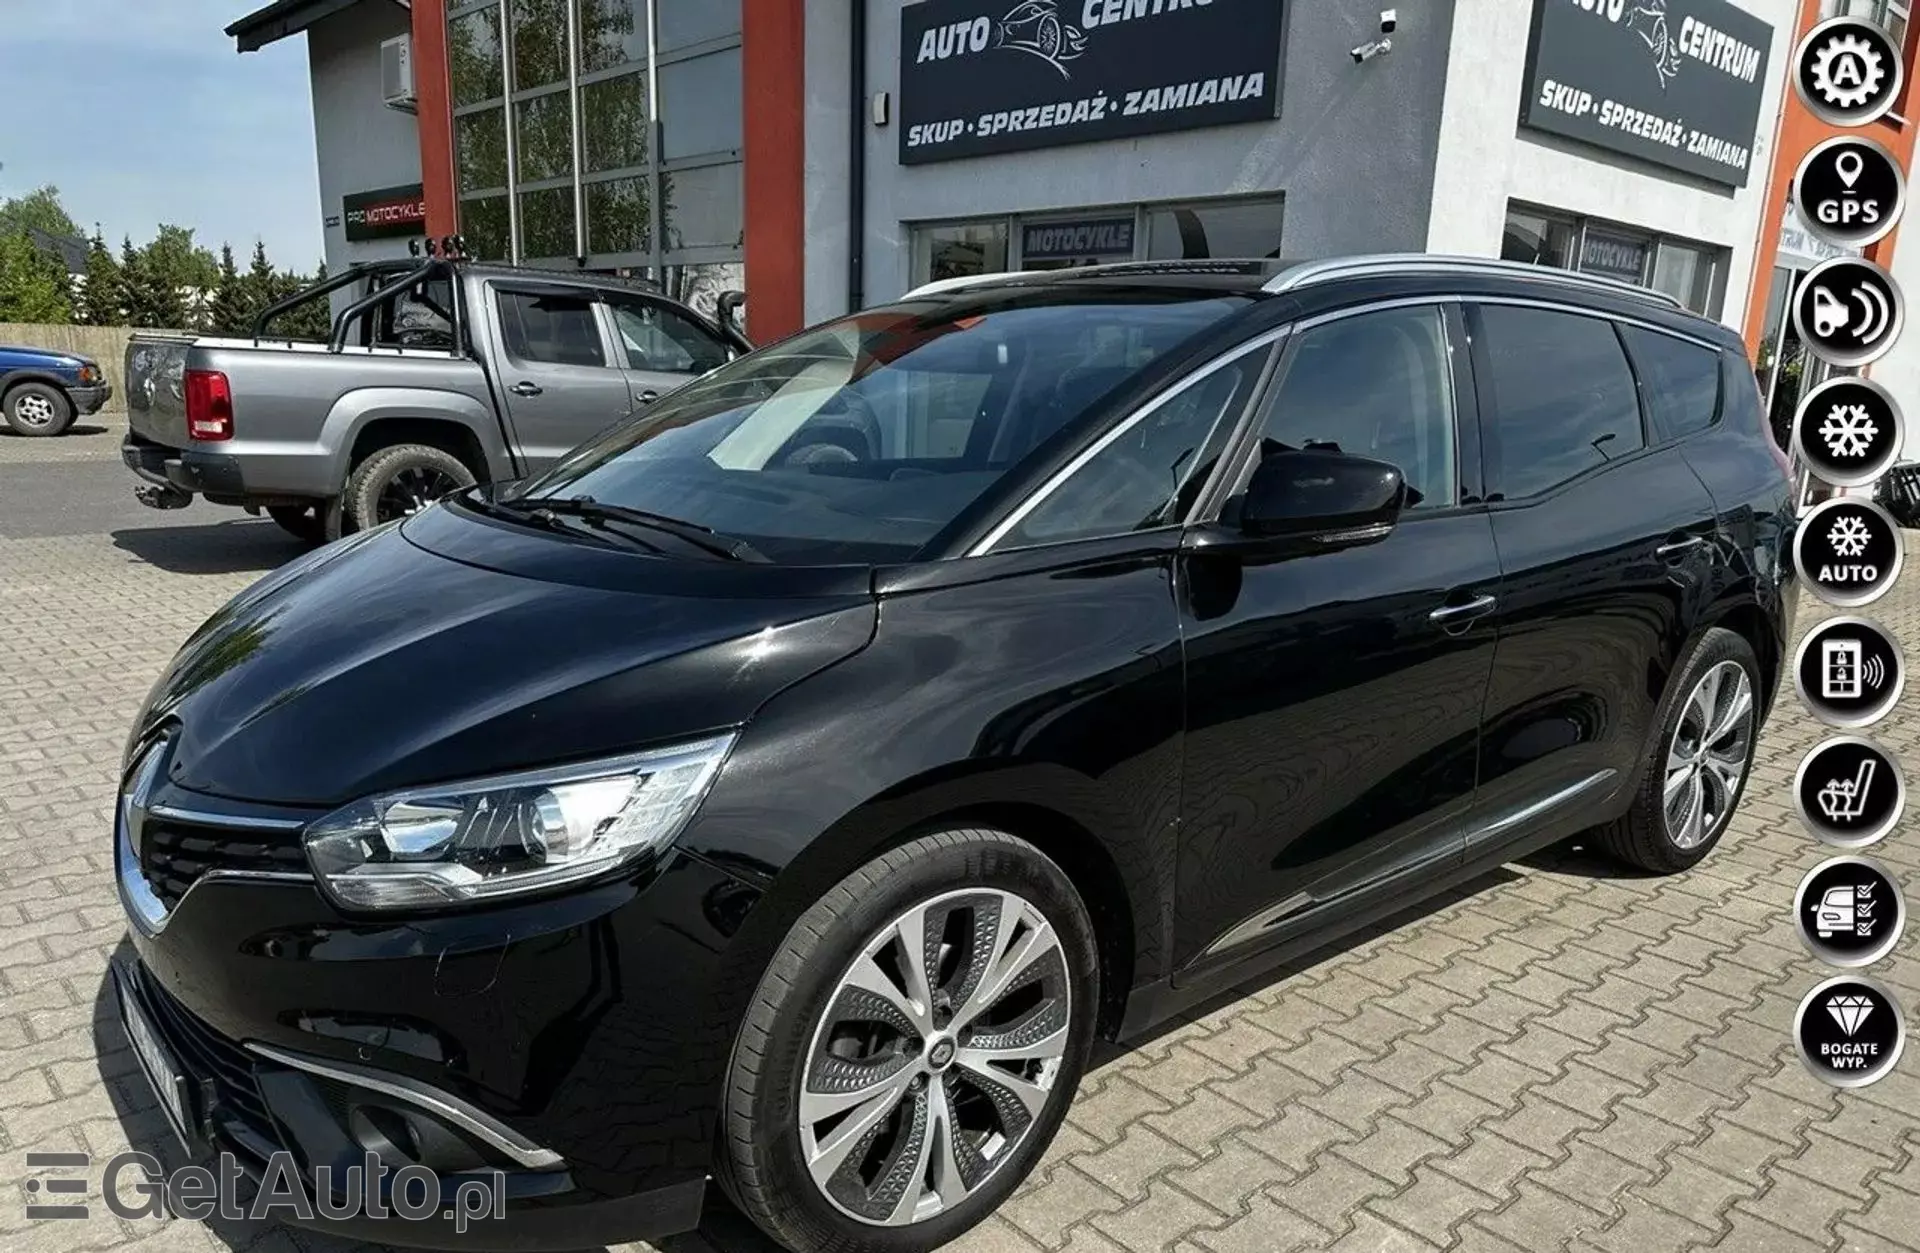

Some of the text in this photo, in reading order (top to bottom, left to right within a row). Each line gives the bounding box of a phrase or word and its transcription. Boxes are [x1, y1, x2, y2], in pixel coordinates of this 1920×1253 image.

[917, 17, 990, 63] AUTO
[1678, 15, 1761, 84] CENTRUM
[908, 72, 1264, 147] SKUP SPRZEDAŻ ZAMIANA
[1539, 79, 1749, 169] SKUP SPRZEDAŻ ZAMIANA
[1026, 224, 1132, 252] MOTOCYKLE
